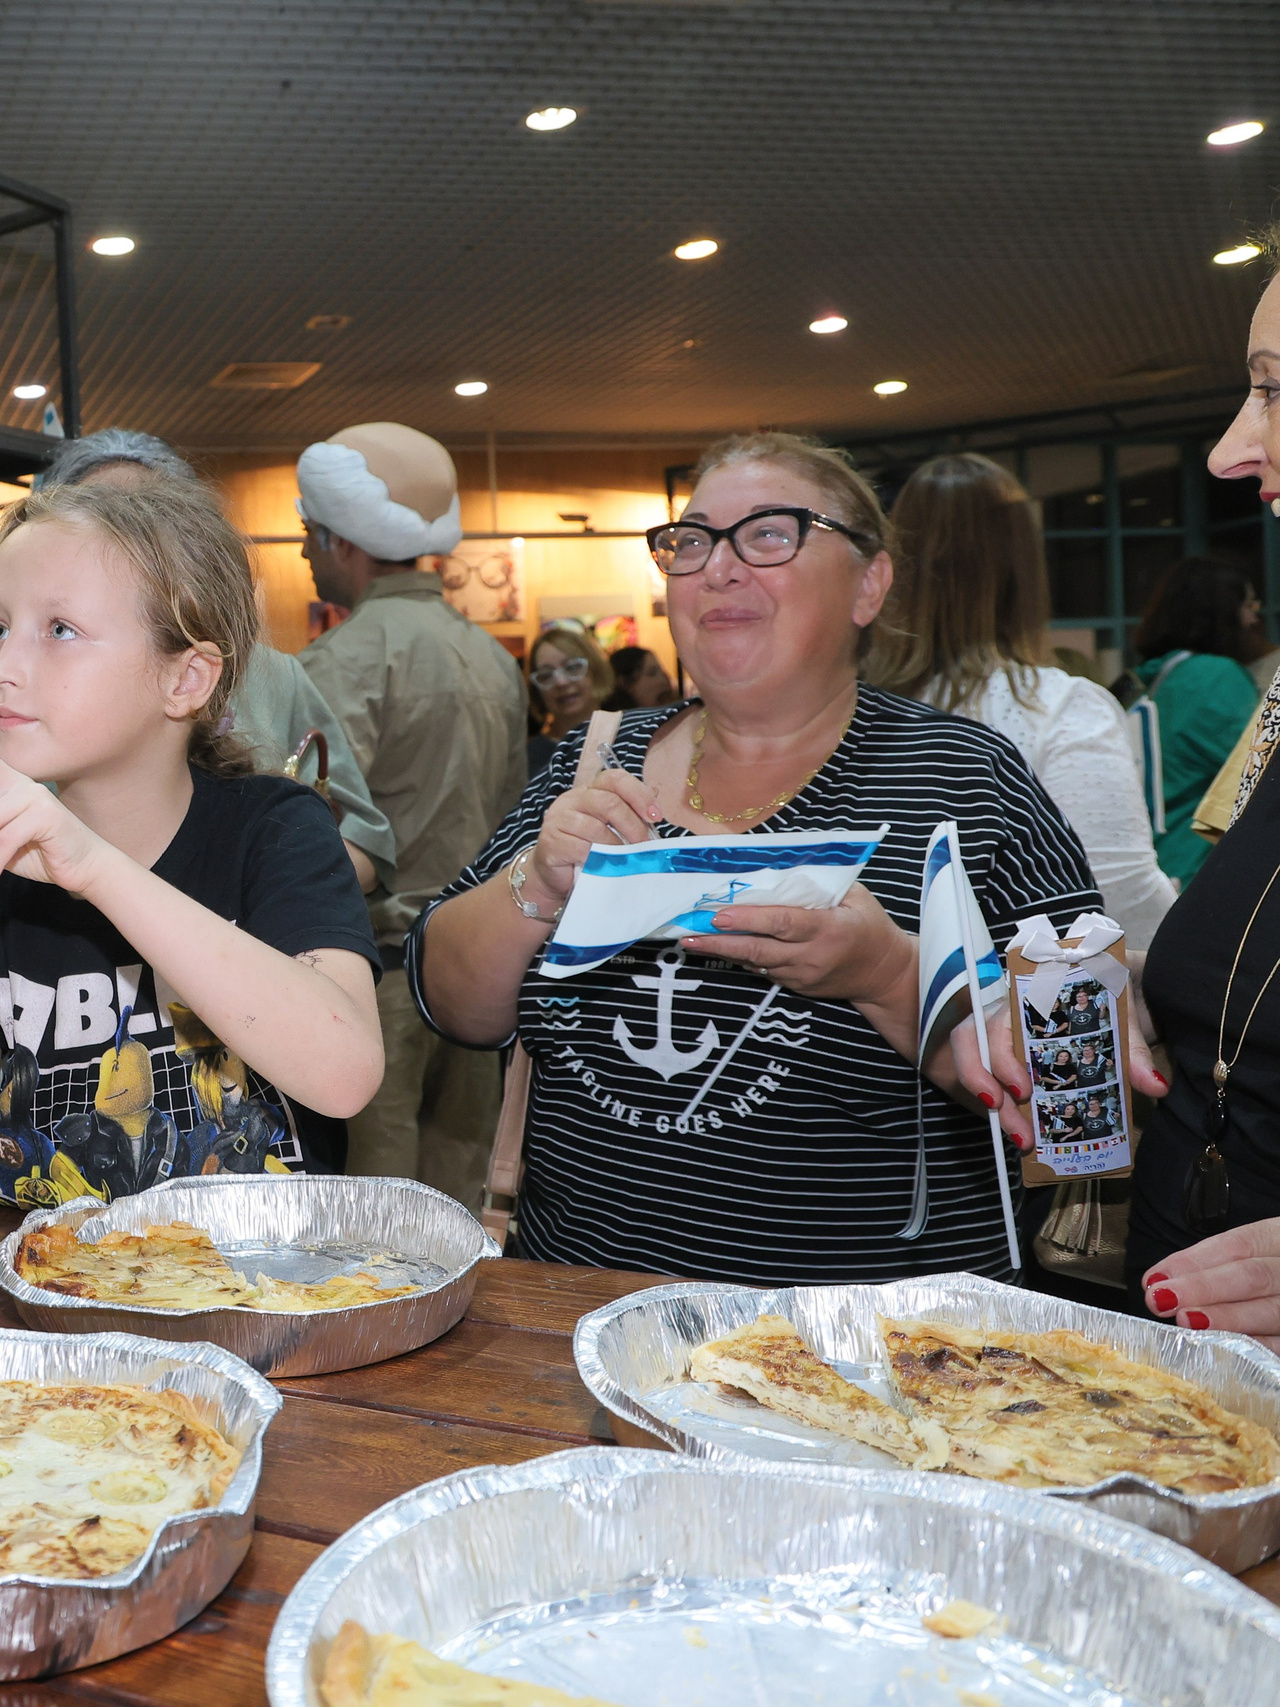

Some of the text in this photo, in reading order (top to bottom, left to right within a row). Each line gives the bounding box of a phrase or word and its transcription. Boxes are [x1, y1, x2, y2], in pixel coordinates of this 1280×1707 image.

[557, 1046, 791, 1134] TAGLINE GOES HERE
[1084, 1162, 1106, 1171] נהריה
